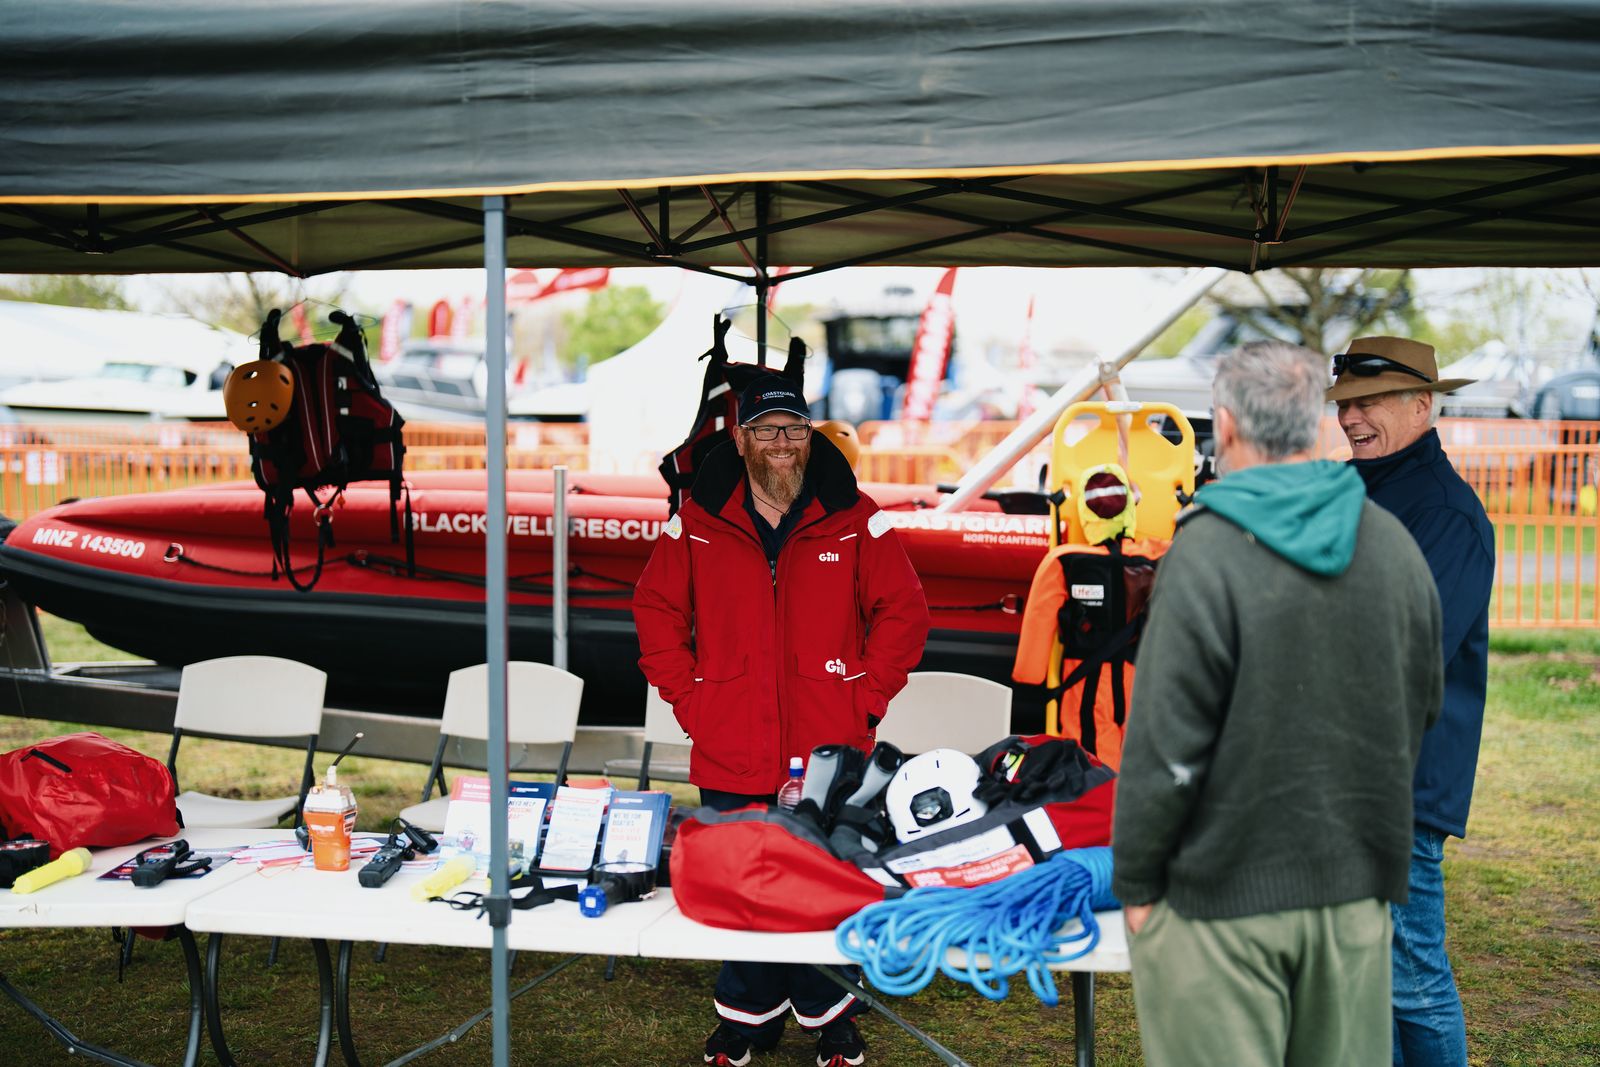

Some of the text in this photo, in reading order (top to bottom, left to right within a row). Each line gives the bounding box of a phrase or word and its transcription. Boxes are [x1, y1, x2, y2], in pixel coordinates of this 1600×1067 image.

[761, 390, 796, 399] COASTGUARD
[403, 511, 557, 536] BLACKELL
[890, 510, 1066, 535] OASTGUARD
[32, 527, 145, 559] MNZ 143500
[963, 533, 1051, 548] NORTH CANTERBU
[818, 551, 840, 562] Gill
[825, 658, 846, 676] Gill
